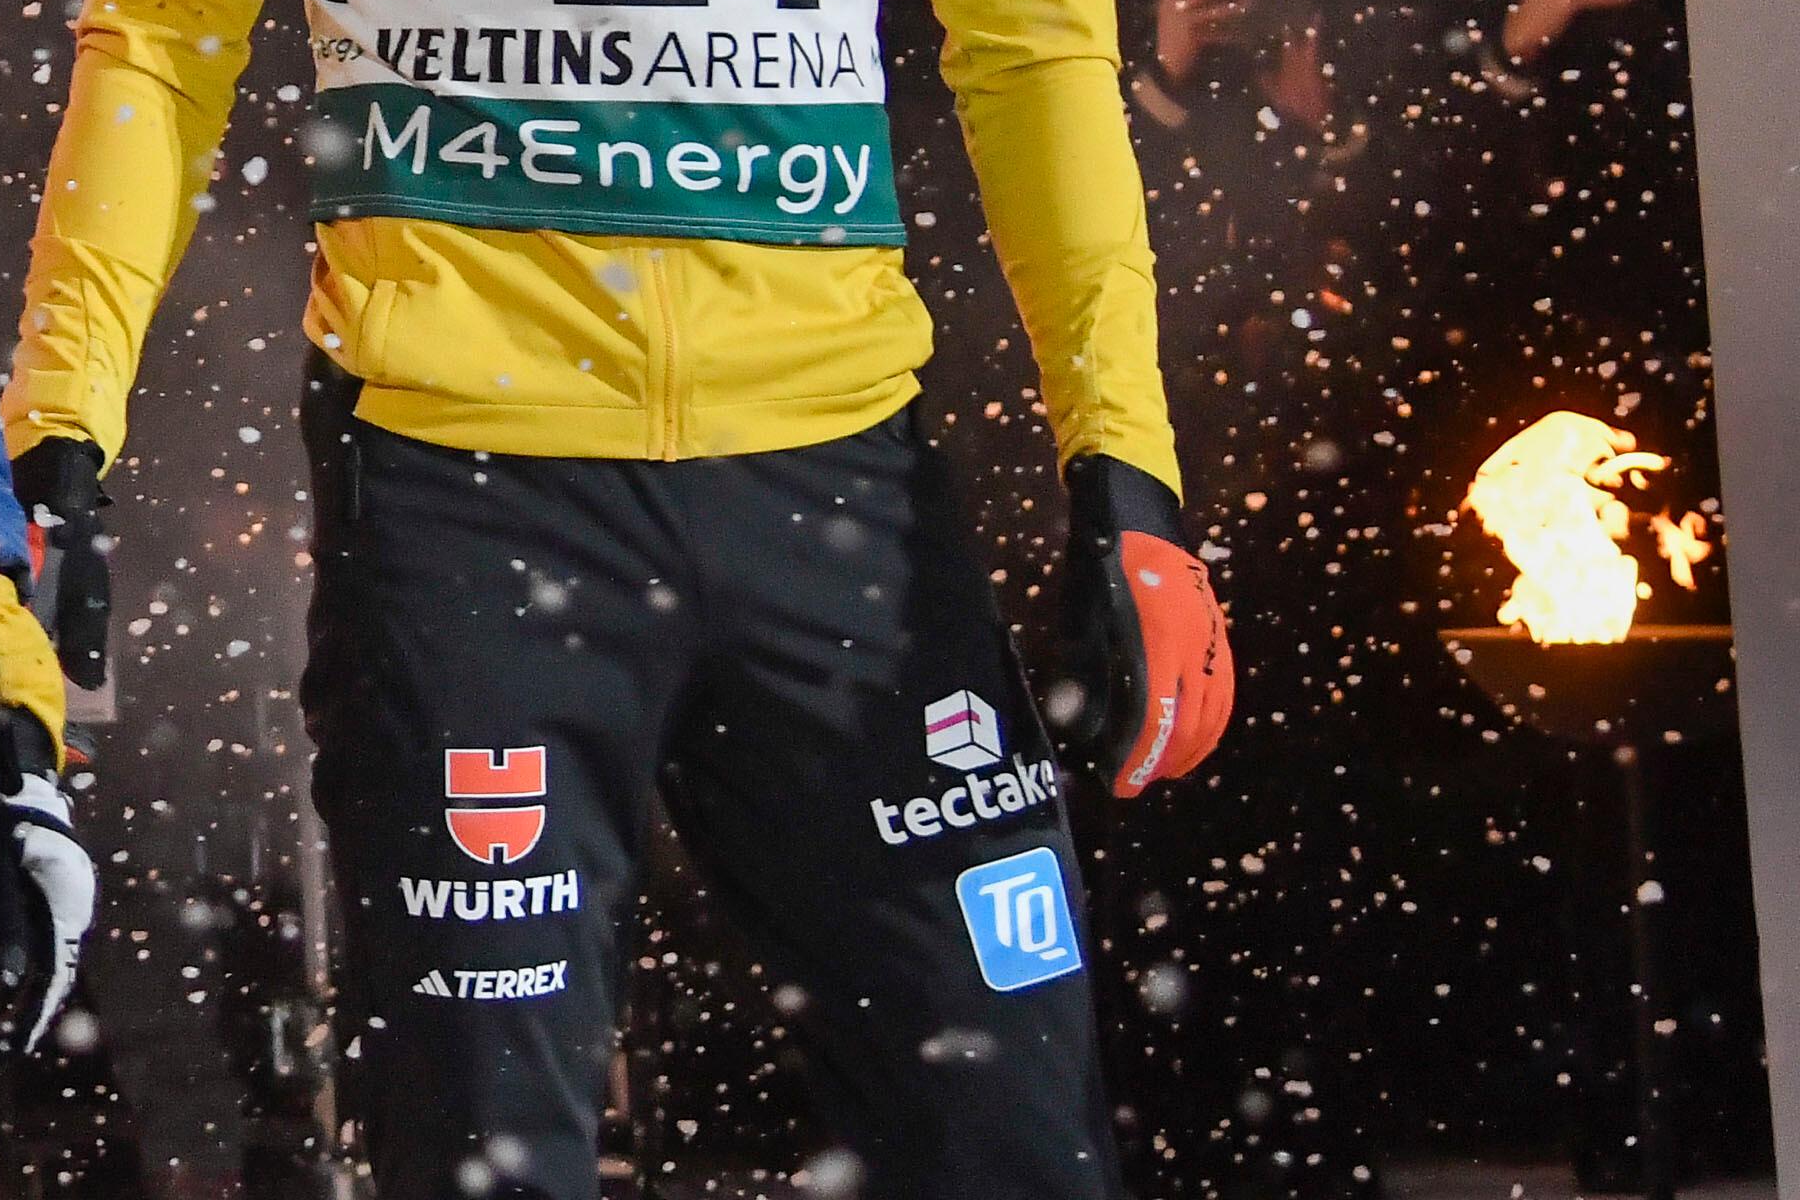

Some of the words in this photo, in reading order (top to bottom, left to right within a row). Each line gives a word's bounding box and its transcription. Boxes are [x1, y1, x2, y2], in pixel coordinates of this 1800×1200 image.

[362, 101, 870, 216] M4Energy
[400, 870, 579, 921] WÜRTH
[978, 871, 1068, 961] TQ
[453, 960, 568, 999] TERREX
